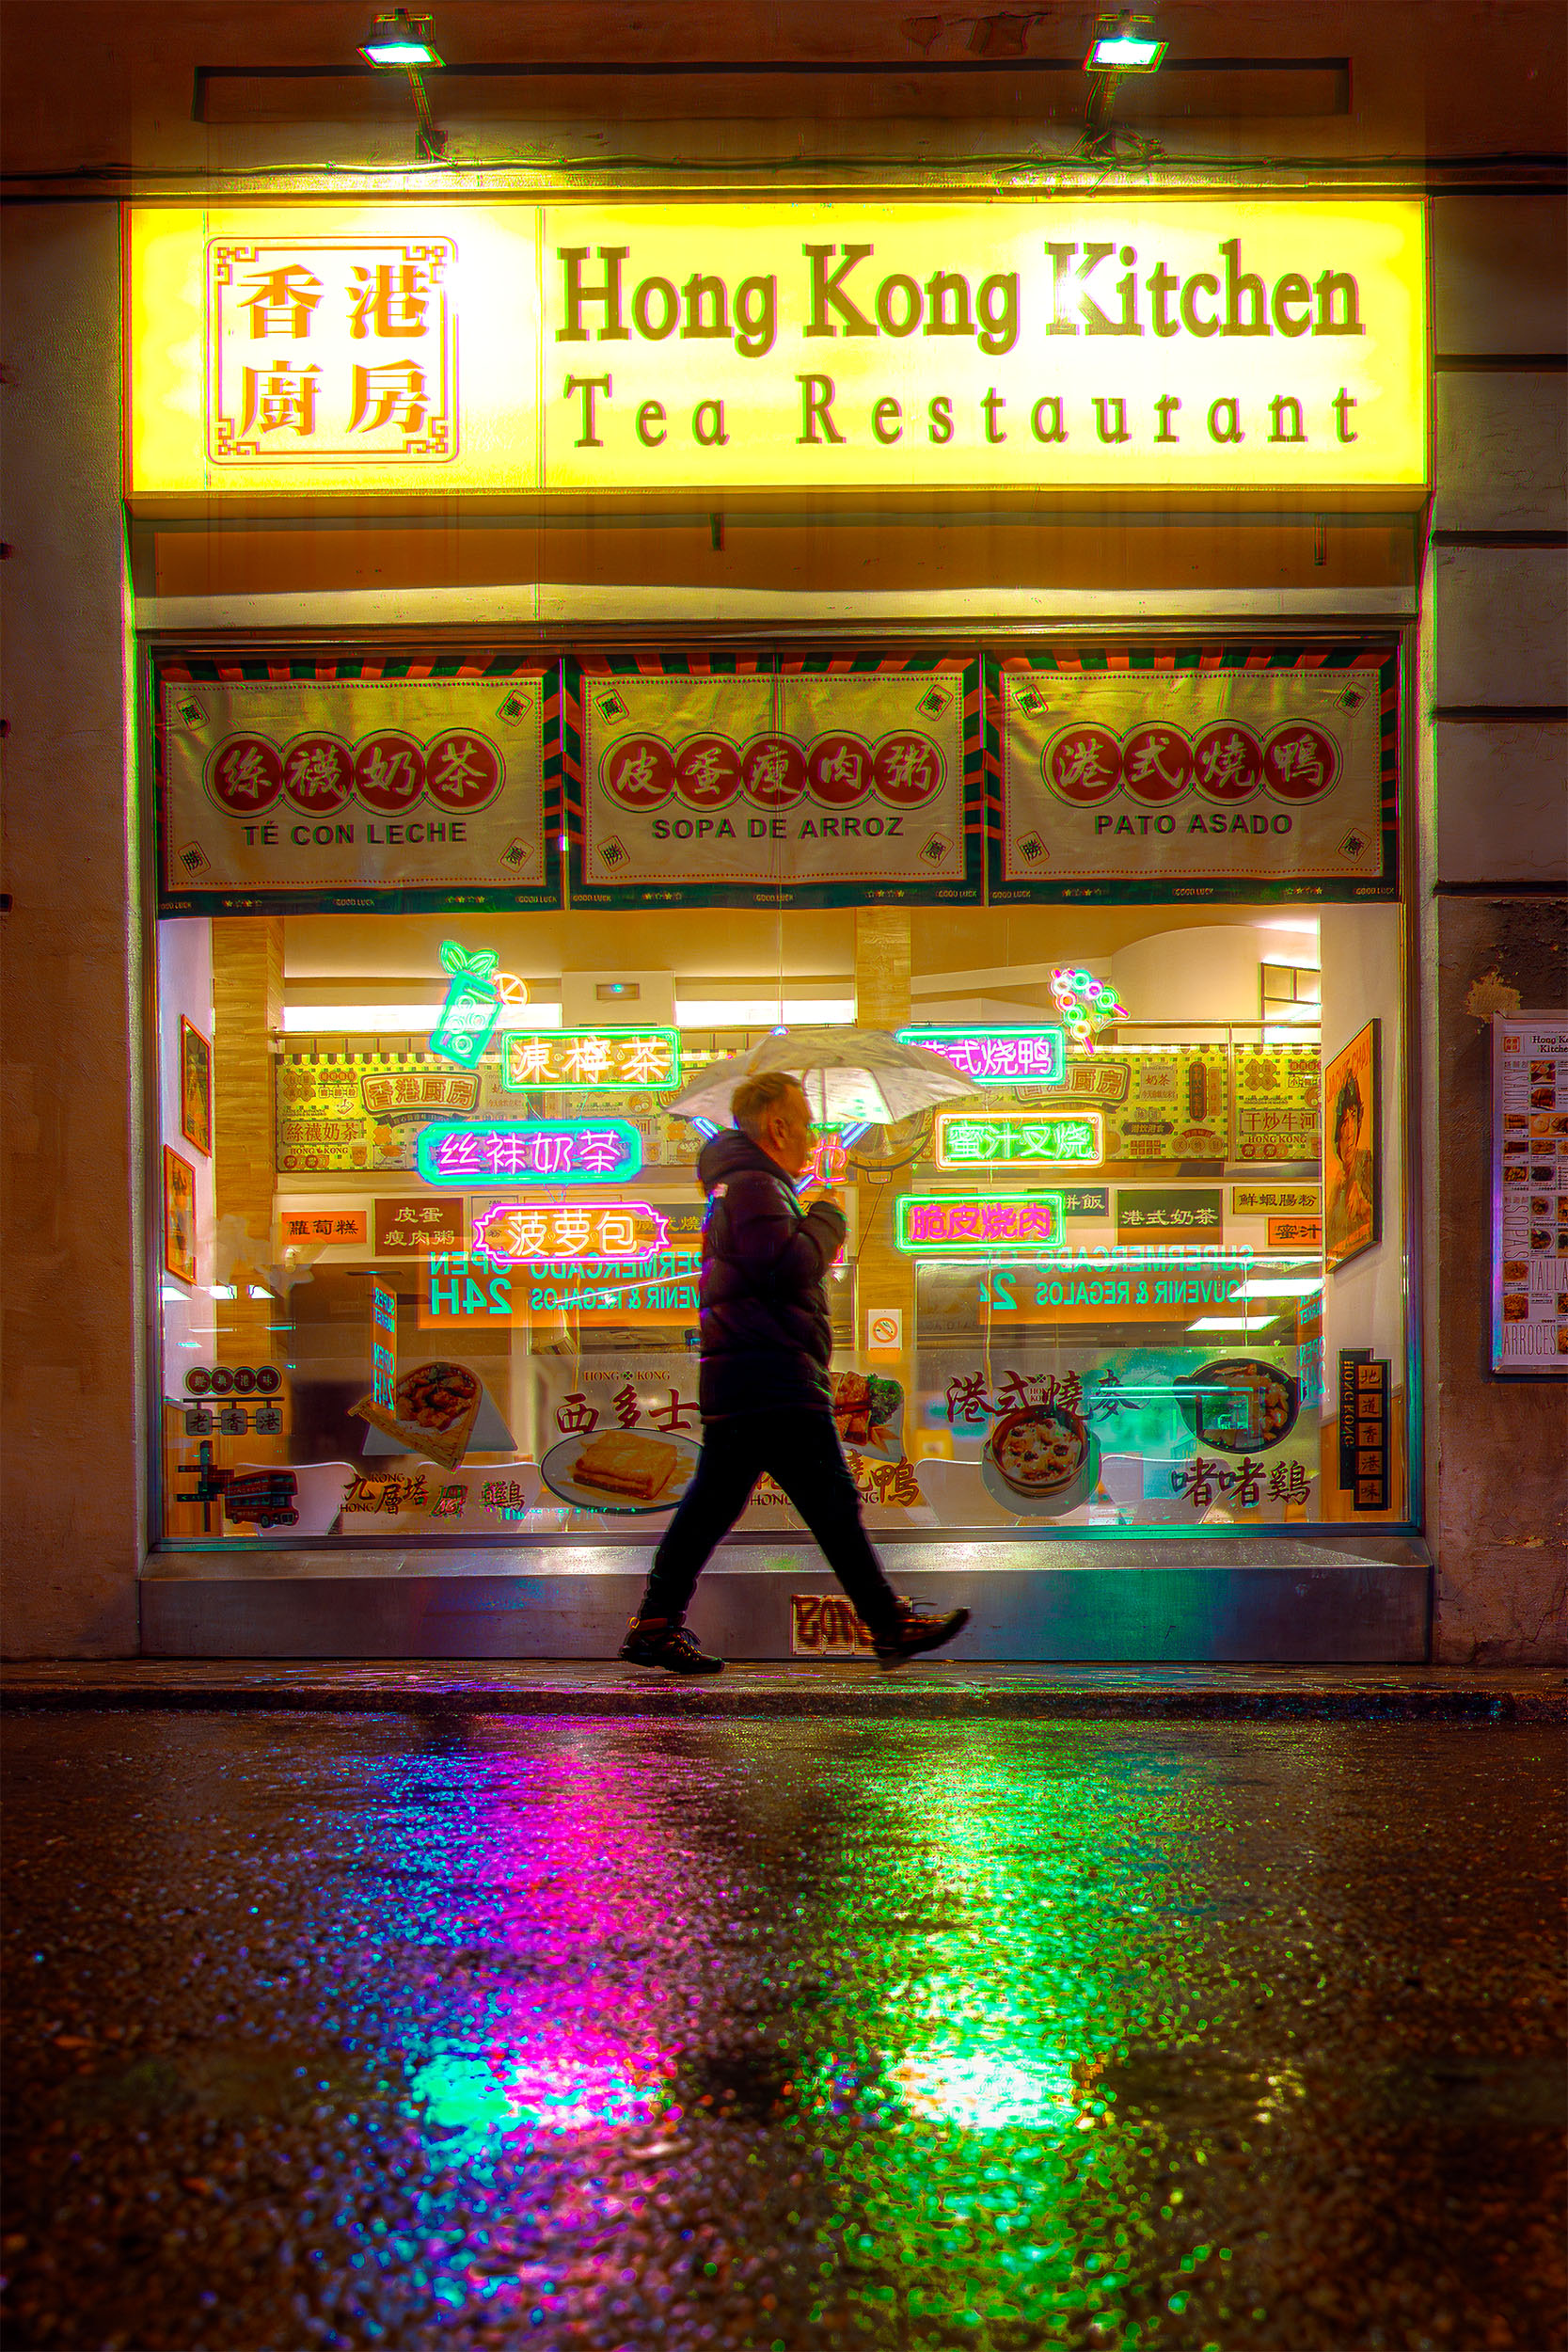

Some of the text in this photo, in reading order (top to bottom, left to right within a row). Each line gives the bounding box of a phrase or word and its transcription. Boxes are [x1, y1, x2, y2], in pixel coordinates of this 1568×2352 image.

[238, 262, 431, 340] 香港
[555, 238, 1367, 358] Hong Kong Kitchen
[238, 358, 431, 438] 廚房
[563, 373, 1359, 448] Tea Restaurant
[220, 740, 488, 801] 絲襪奶茶
[617, 745, 933, 796] 皮蛋瘦肉粥
[1056, 734, 1324, 789] 港式燒鴨
[242, 820, 467, 846] TÉ CON LECHE
[651, 817, 904, 839] SOPA DE ARROZ
[1094, 813, 1293, 834] PATO ASADO
[1532, 1036, 1557, 1044] Hong
[369, 1078, 474, 1107] 香港厨房
[438, 1130, 621, 1175] 丝袜奶茶
[948, 1120, 1095, 1160] 蜜汁叉烧
[395, 1207, 444, 1224] 皮蛋
[910, 1203, 1052, 1240] 脆皮烧肉
[1121, 1208, 1219, 1227] 港式奶茶
[384, 1230, 456, 1247] 瘦肉粥
[507, 1209, 637, 1257] 菠萝包
[1504, 1325, 1556, 1355] ARROCES
[583, 1371, 670, 1381] HONG KONG
[190, 1413, 281, 1434] 老香港
[556, 1384, 701, 1434] 西多士
[340, 1502, 375, 1513] HONG
